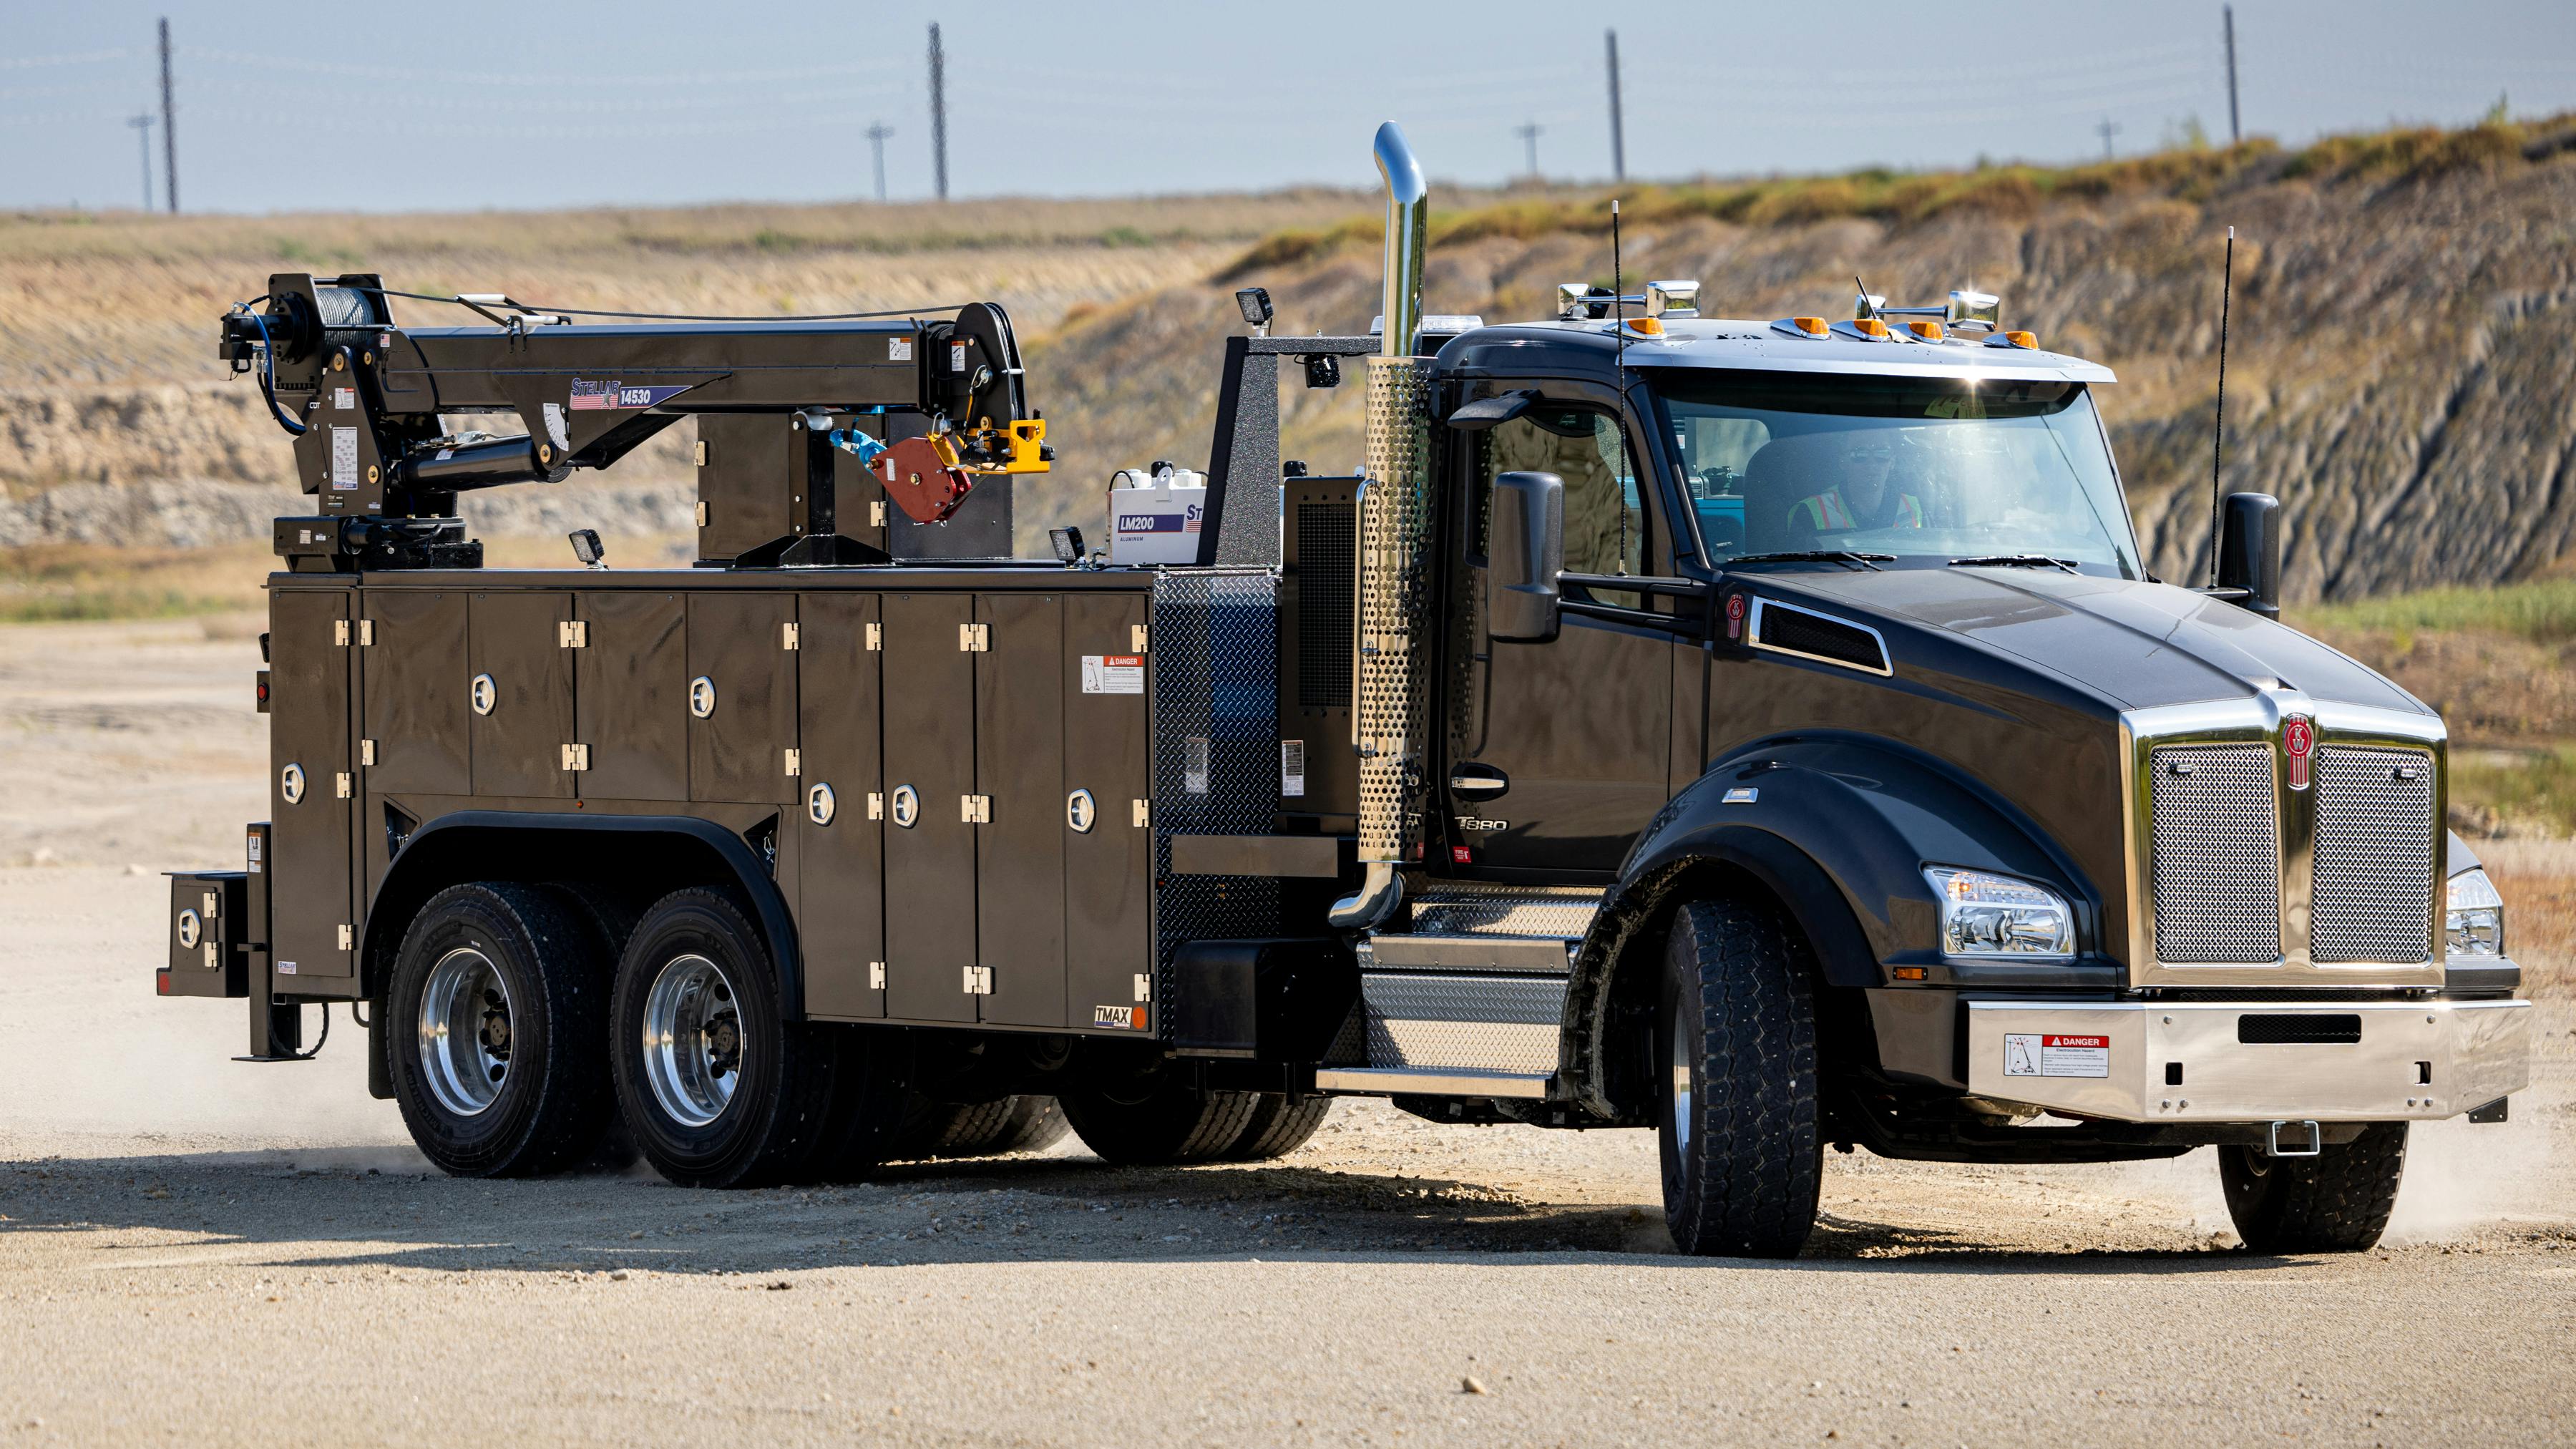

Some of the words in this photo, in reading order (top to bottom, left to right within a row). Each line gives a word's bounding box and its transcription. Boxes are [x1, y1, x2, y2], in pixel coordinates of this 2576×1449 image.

[572, 378, 619, 396] STELLAR
[621, 389, 650, 404] 14530
[1121, 517, 1154, 530] LM200
[1455, 816, 1507, 830] T880
[1096, 1008, 1128, 1023] TMAX
